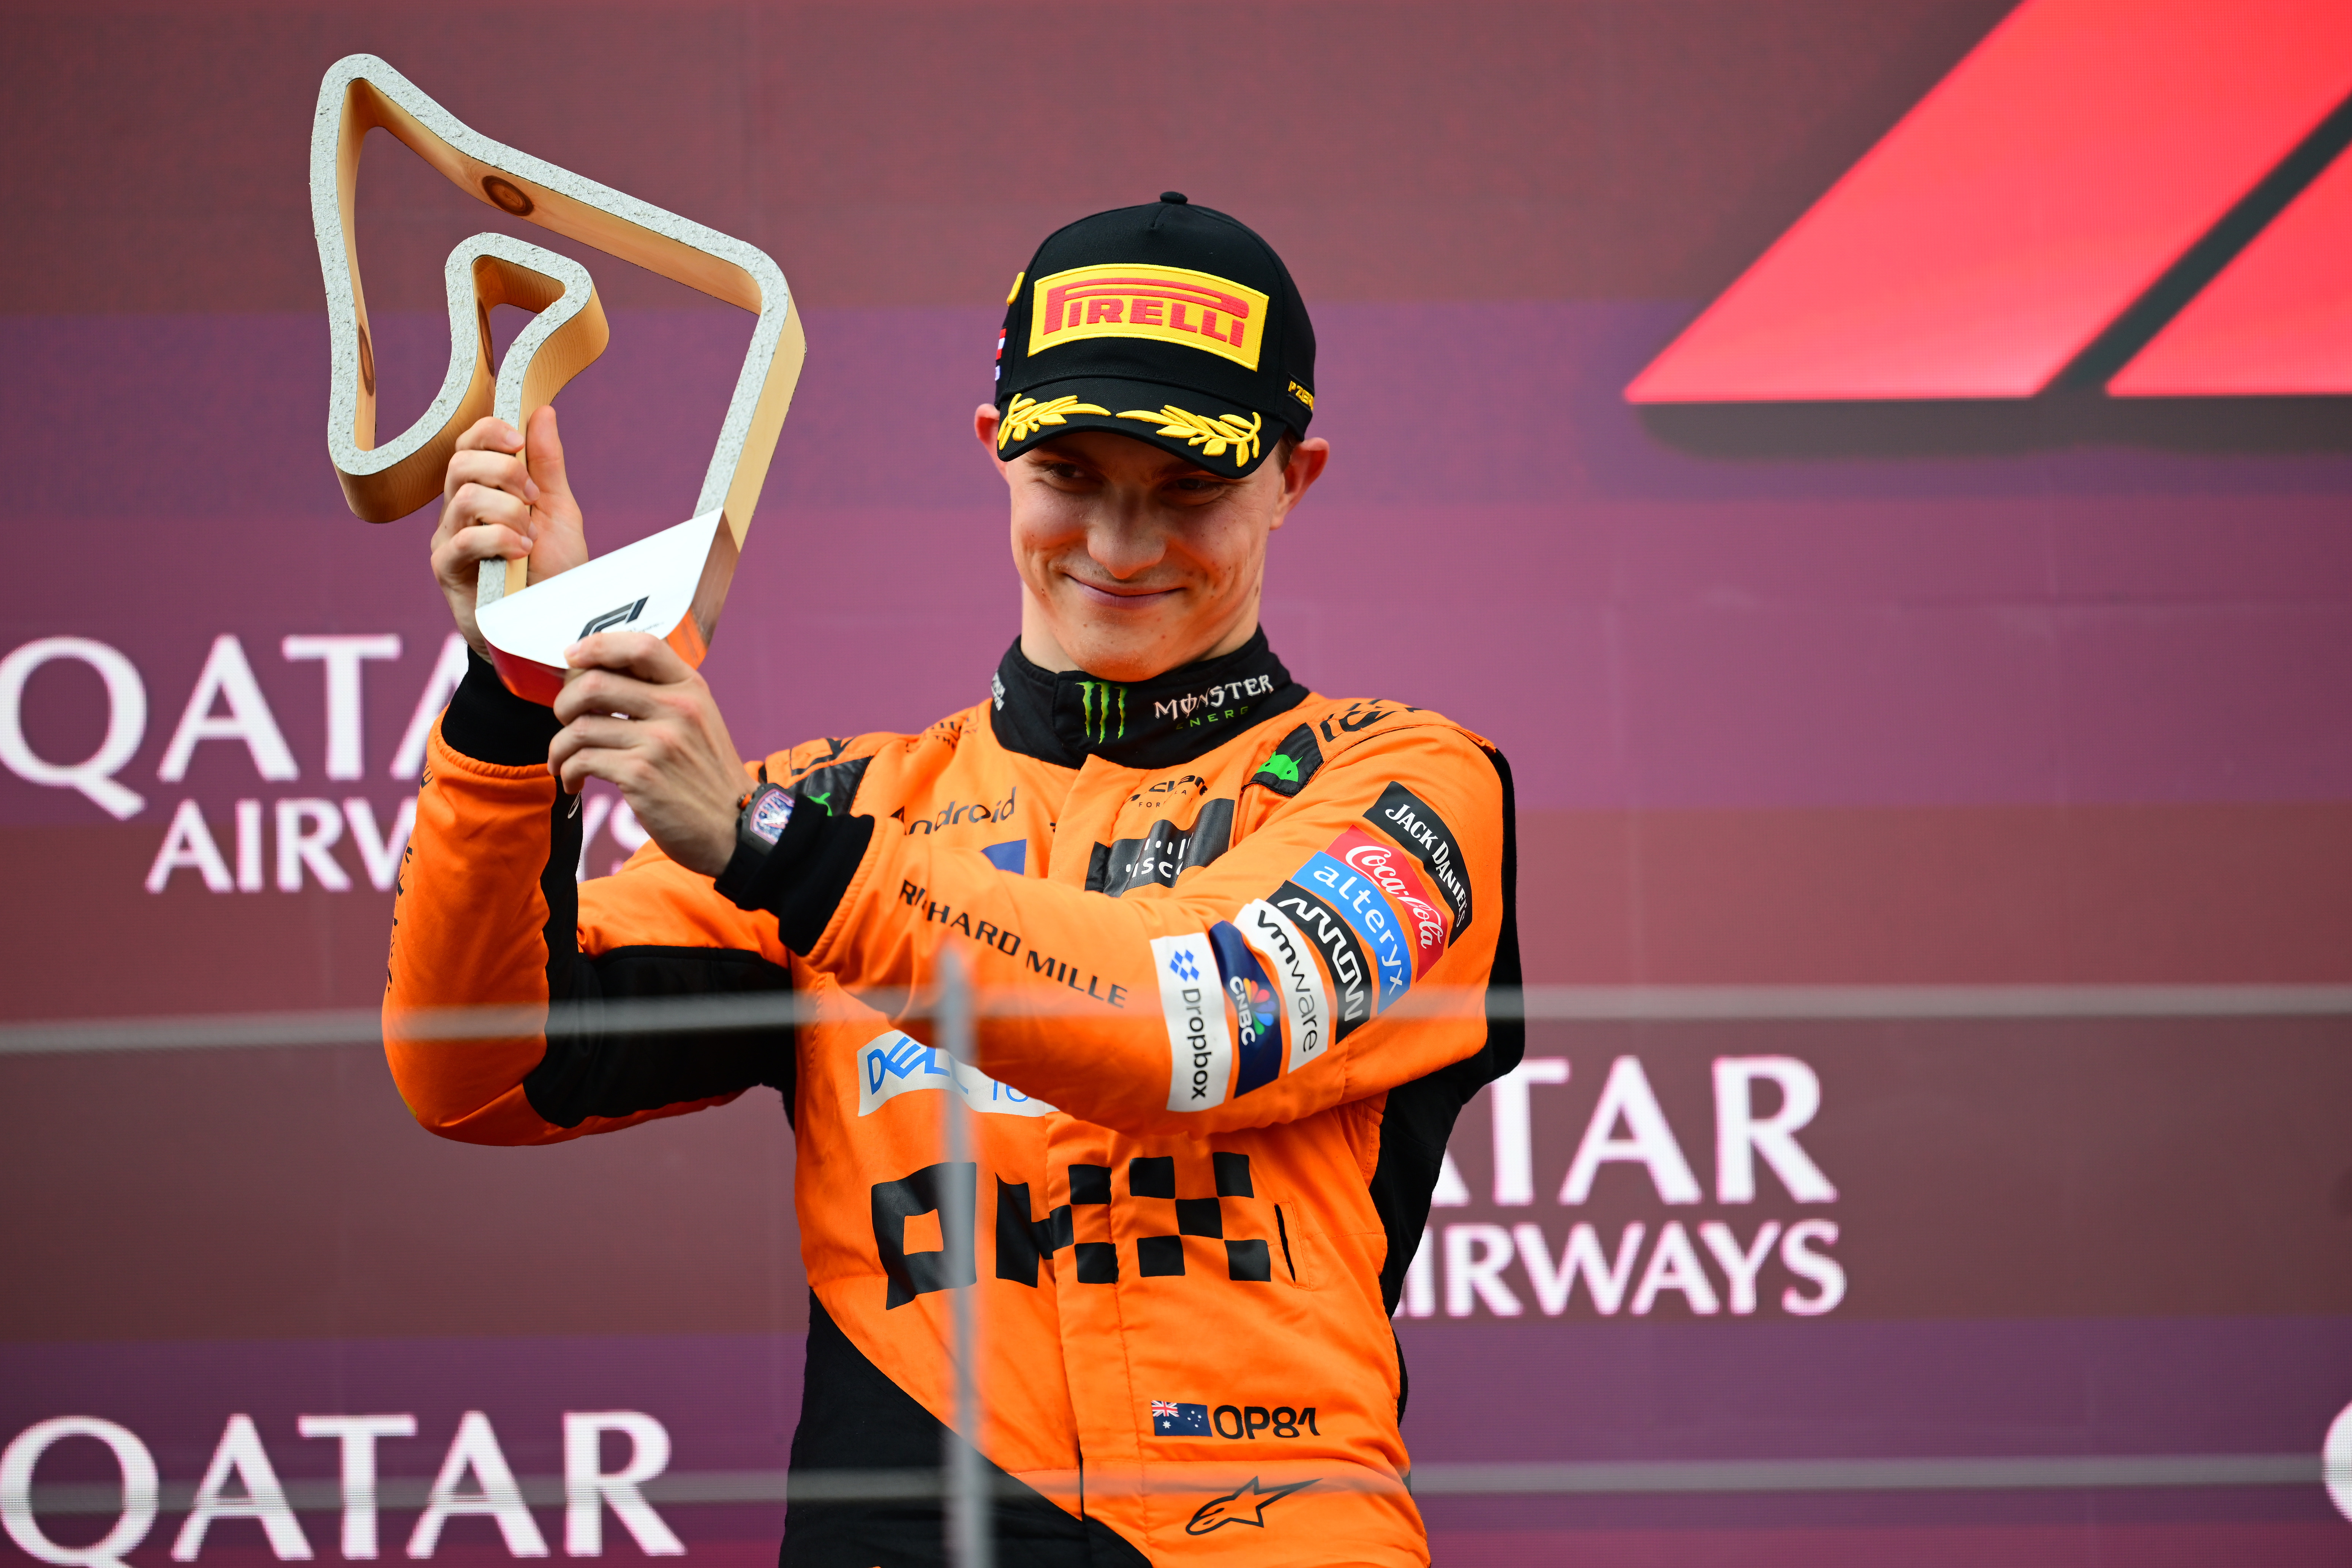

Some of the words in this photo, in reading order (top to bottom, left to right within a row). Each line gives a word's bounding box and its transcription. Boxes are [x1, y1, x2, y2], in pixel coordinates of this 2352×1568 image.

[1043, 277, 1249, 348] PIRELLI
[0, 633, 468, 820] QAT
[1153, 674, 1274, 721] MONSTER
[1176, 706, 1248, 730] ENERG
[1126, 857, 1184, 880] isc
[1385, 804, 1438, 851] JACK
[899, 879, 1021, 956] RIHARD
[1026, 950, 1129, 1009] MILLE
[1313, 866, 1402, 996] alteryx
[1345, 845, 1443, 950] Coca-Cola
[1229, 975, 1256, 1046] CNBC
[1258, 910, 1317, 1053] vmware
[1277, 897, 1364, 1022] ARROW
[1182, 988, 1212, 1100] Dropbox
[1431, 1054, 1840, 1207] TAR
[1391, 1219, 1848, 1318] IRWAYS
[1213, 1404, 1321, 1439] OP81
[0, 1410, 688, 1568] QATAR
